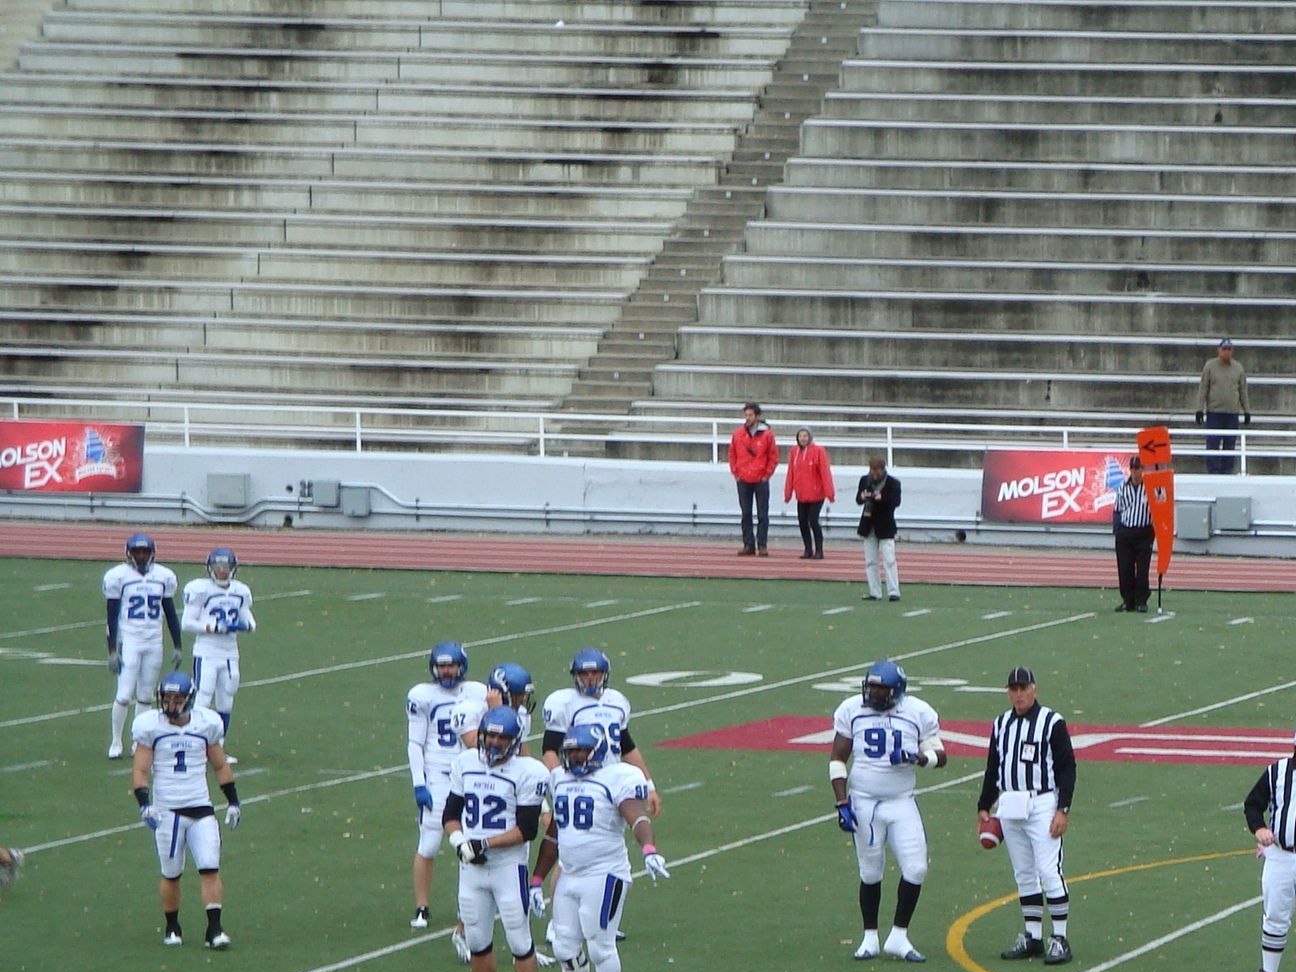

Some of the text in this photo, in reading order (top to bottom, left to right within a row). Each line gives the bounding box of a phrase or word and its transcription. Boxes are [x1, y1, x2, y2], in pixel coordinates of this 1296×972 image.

[0, 437, 66, 469] OLSON
[24, 456, 65, 489] EX
[998, 466, 1085, 501] MOLSON
[1042, 486, 1085, 519] EX
[127, 595, 161, 619] 25
[863, 730, 903, 758] 91
[173, 750, 187, 773] 1
[535, 783, 548, 796] 92
[464, 793, 507, 829] 92
[555, 796, 594, 830] 98
